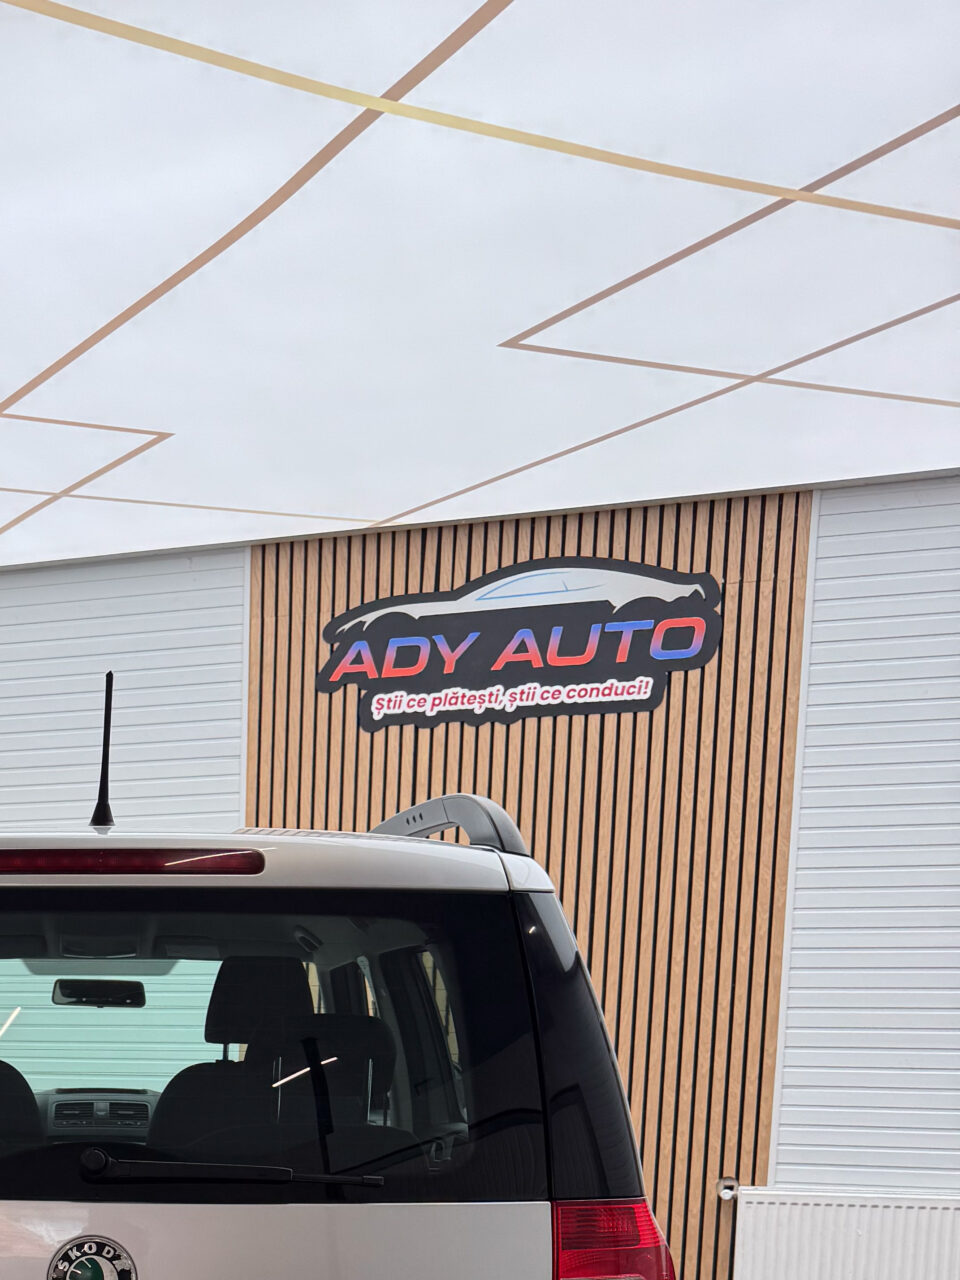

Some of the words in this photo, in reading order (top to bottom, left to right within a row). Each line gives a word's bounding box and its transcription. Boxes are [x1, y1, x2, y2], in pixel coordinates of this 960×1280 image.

[329, 632, 481, 682] ADY
[491, 616, 707, 672] AUTO
[374, 693, 404, 718] Știi
[406, 697, 428, 709] ce
[431, 688, 505, 713] plătești,
[508, 685, 538, 709] știi
[541, 688, 563, 702] ce
[566, 679, 650, 700] conduci!
